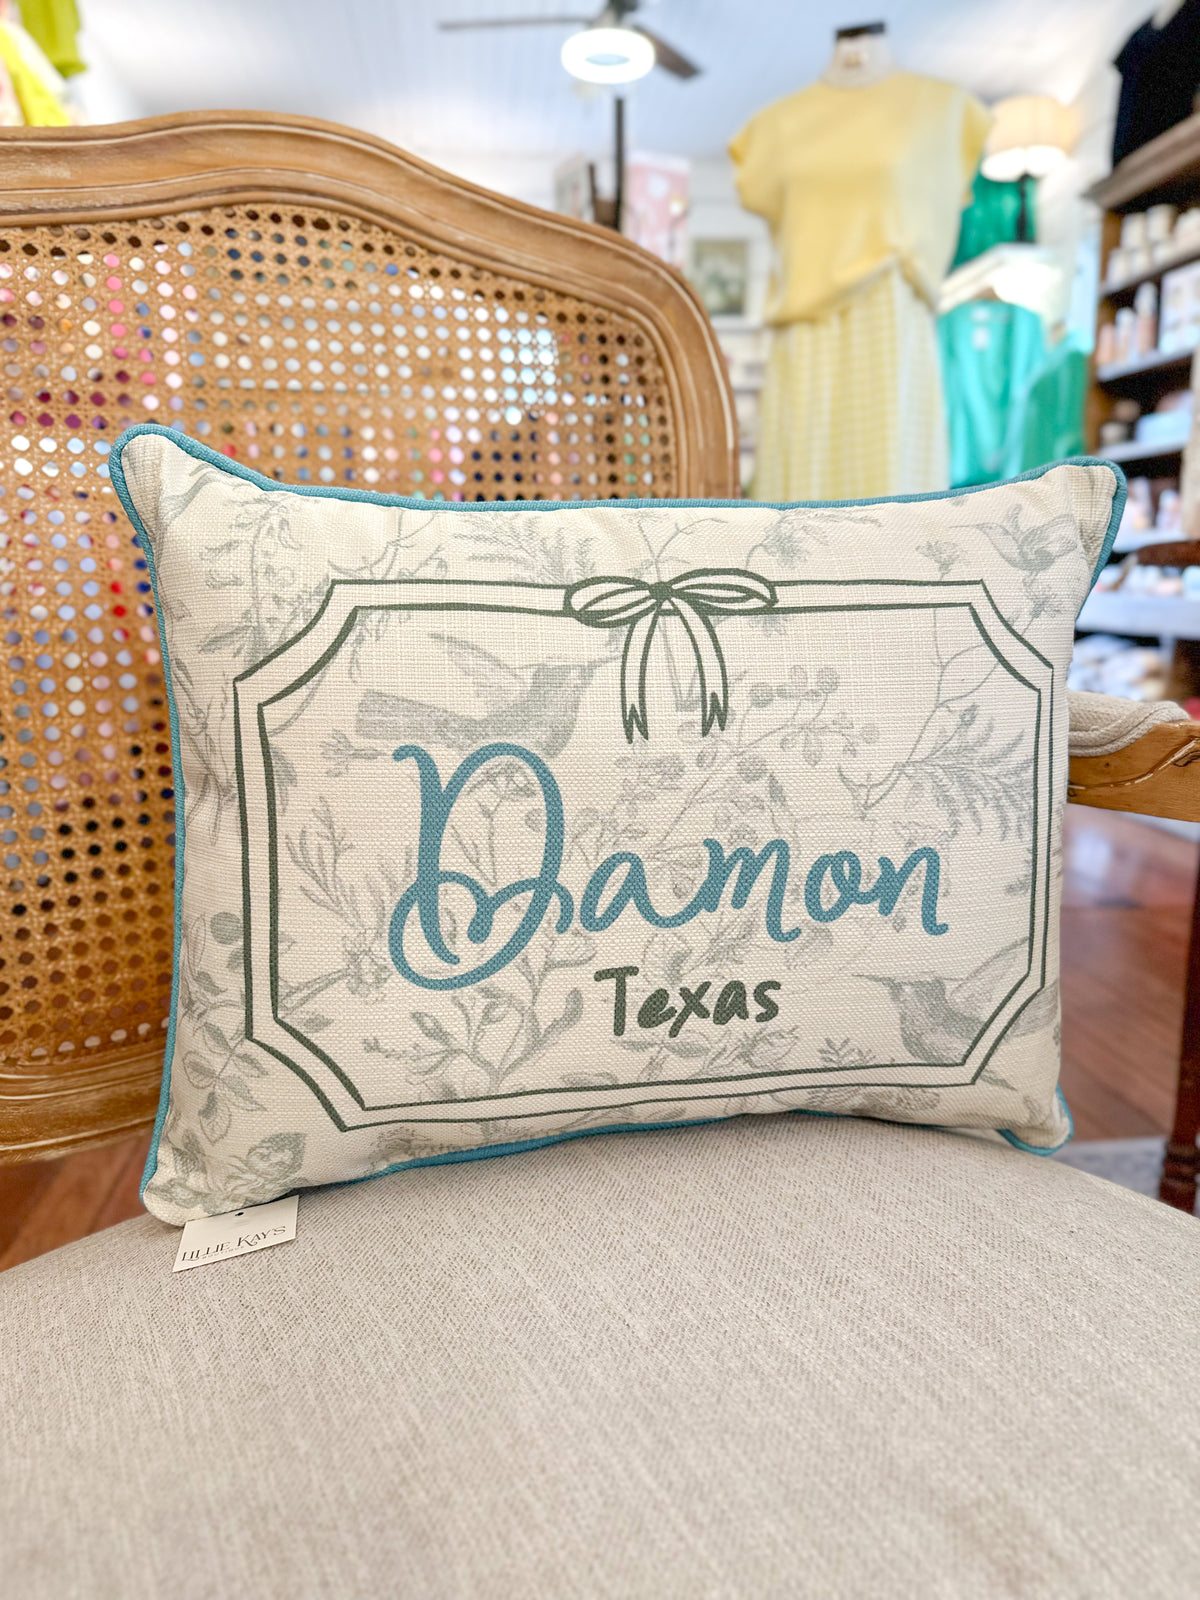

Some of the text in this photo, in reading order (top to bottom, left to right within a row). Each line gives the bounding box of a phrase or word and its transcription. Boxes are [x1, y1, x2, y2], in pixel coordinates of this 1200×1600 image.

[389, 742, 949, 990] Damon
[594, 966, 781, 1038] Texas
[181, 1241, 231, 1262] LILLIE
